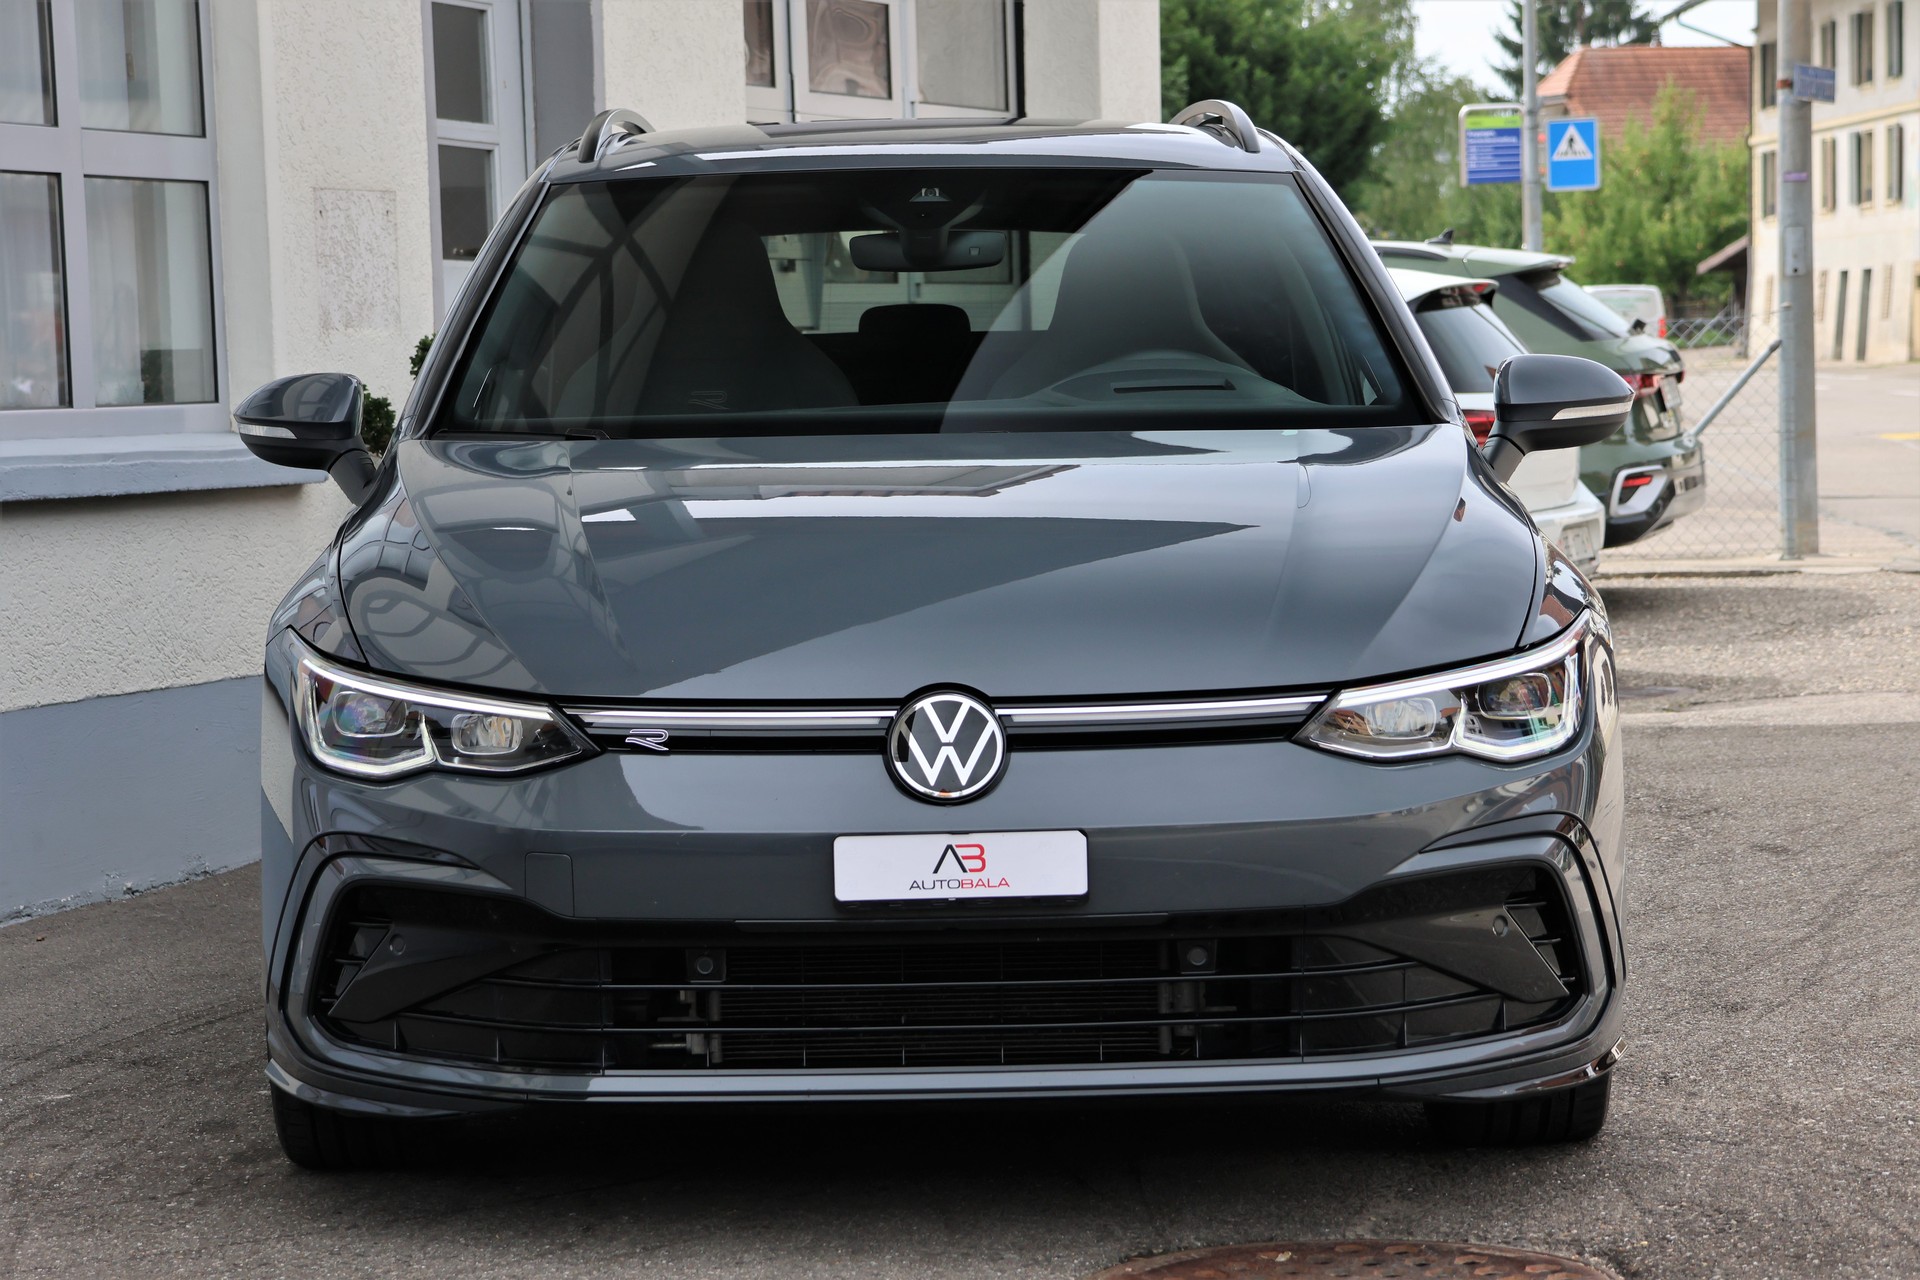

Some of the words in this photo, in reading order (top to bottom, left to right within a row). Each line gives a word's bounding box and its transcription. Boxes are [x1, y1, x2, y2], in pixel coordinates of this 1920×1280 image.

[625, 729, 669, 750] R
[896, 697, 999, 788] VW
[932, 843, 987, 874] AB
[909, 877, 1010, 891] AUTOBALA
